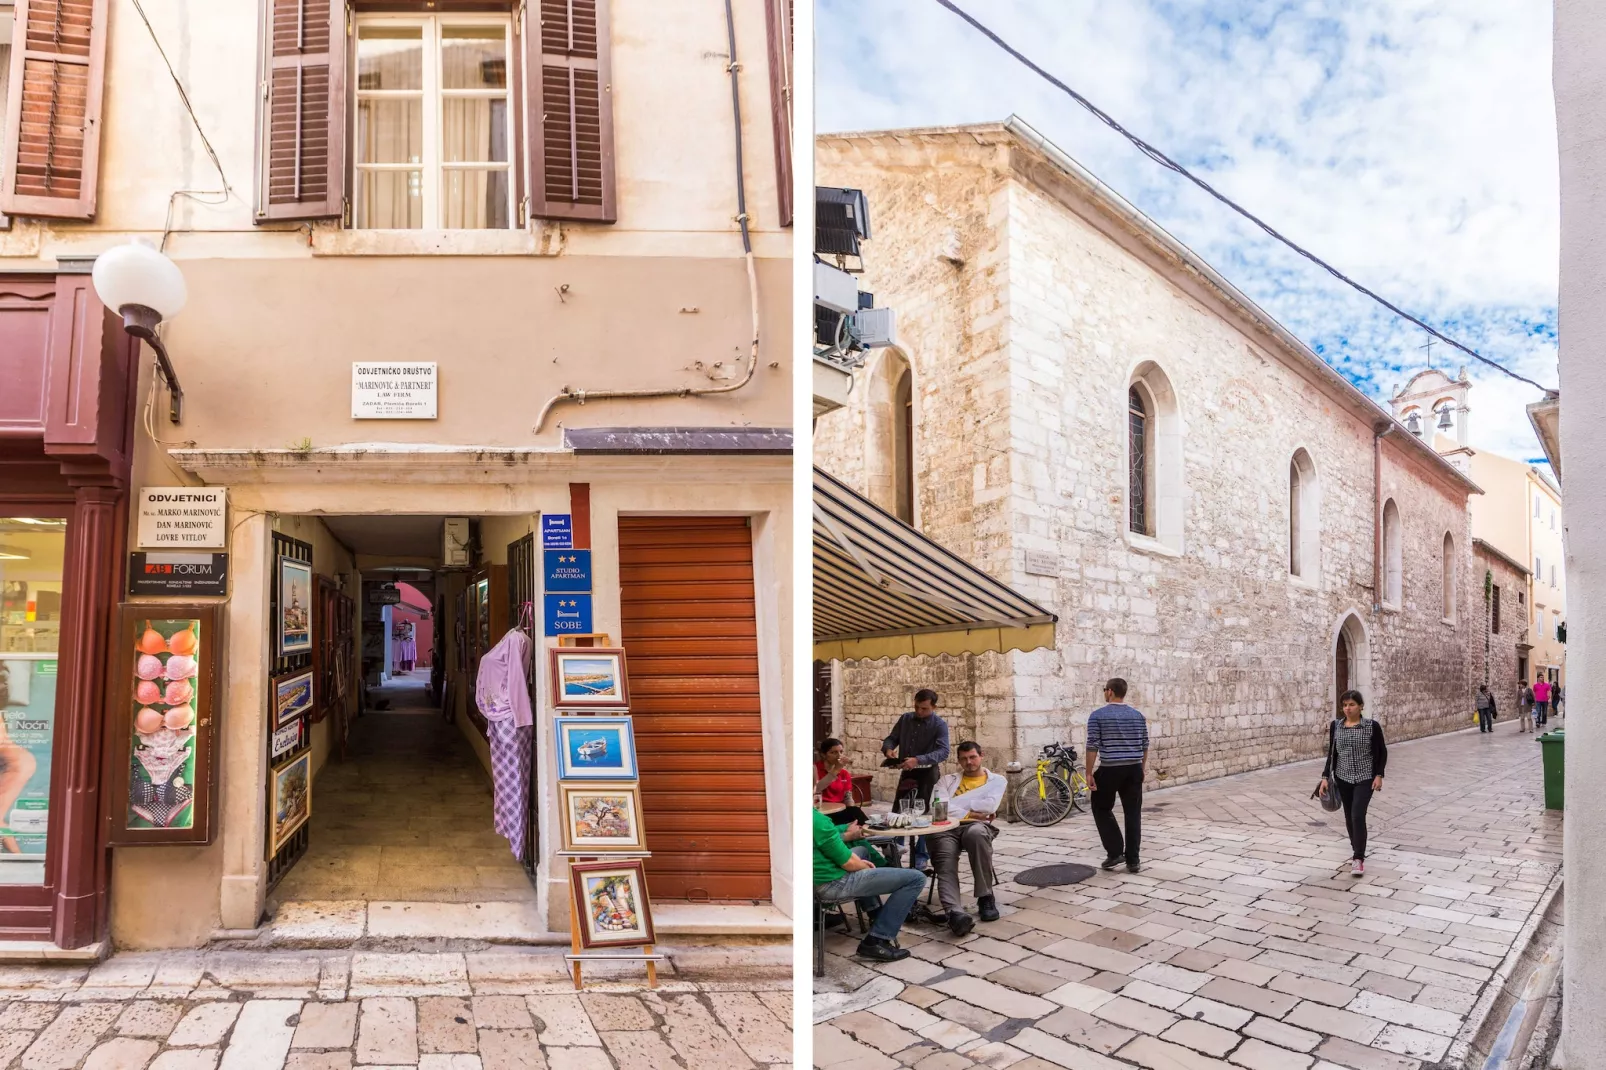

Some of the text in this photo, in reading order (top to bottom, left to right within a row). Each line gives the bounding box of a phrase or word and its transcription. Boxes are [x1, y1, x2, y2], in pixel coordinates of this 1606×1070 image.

[357, 366, 432, 375] ODVJETNIČKO DRUŠTVO
[394, 382, 400, 390] &
[148, 494, 217, 503] ODVJETNICI
[157, 508, 182, 516] MARKO
[182, 506, 221, 517] MARINOVIĆ
[156, 520, 213, 529] DAN MARINOVIĆ
[156, 533, 208, 541] LOVRE VITLOV
[173, 564, 212, 574] FORUM
[554, 621, 583, 630] SOBE
